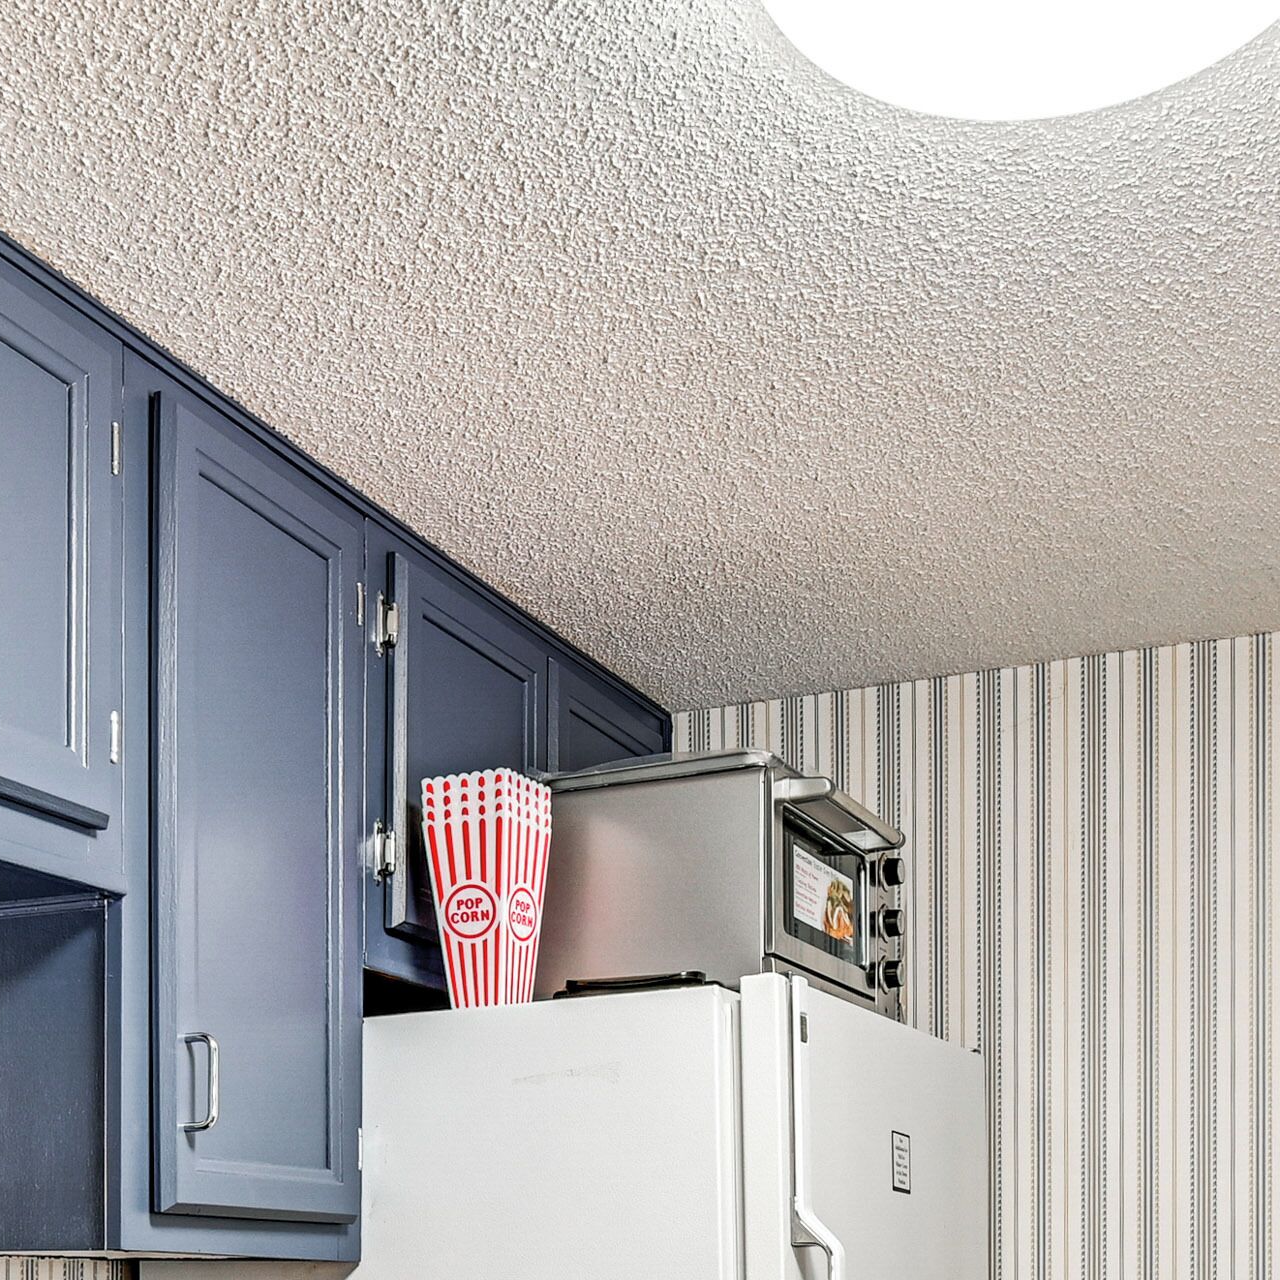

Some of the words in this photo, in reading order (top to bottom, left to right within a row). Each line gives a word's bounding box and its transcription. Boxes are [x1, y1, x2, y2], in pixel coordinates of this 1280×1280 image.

[456, 898, 483, 910] POP
[515, 900, 531, 913] POP
[450, 909, 490, 924] CORN
[510, 912, 533, 927] CORN
